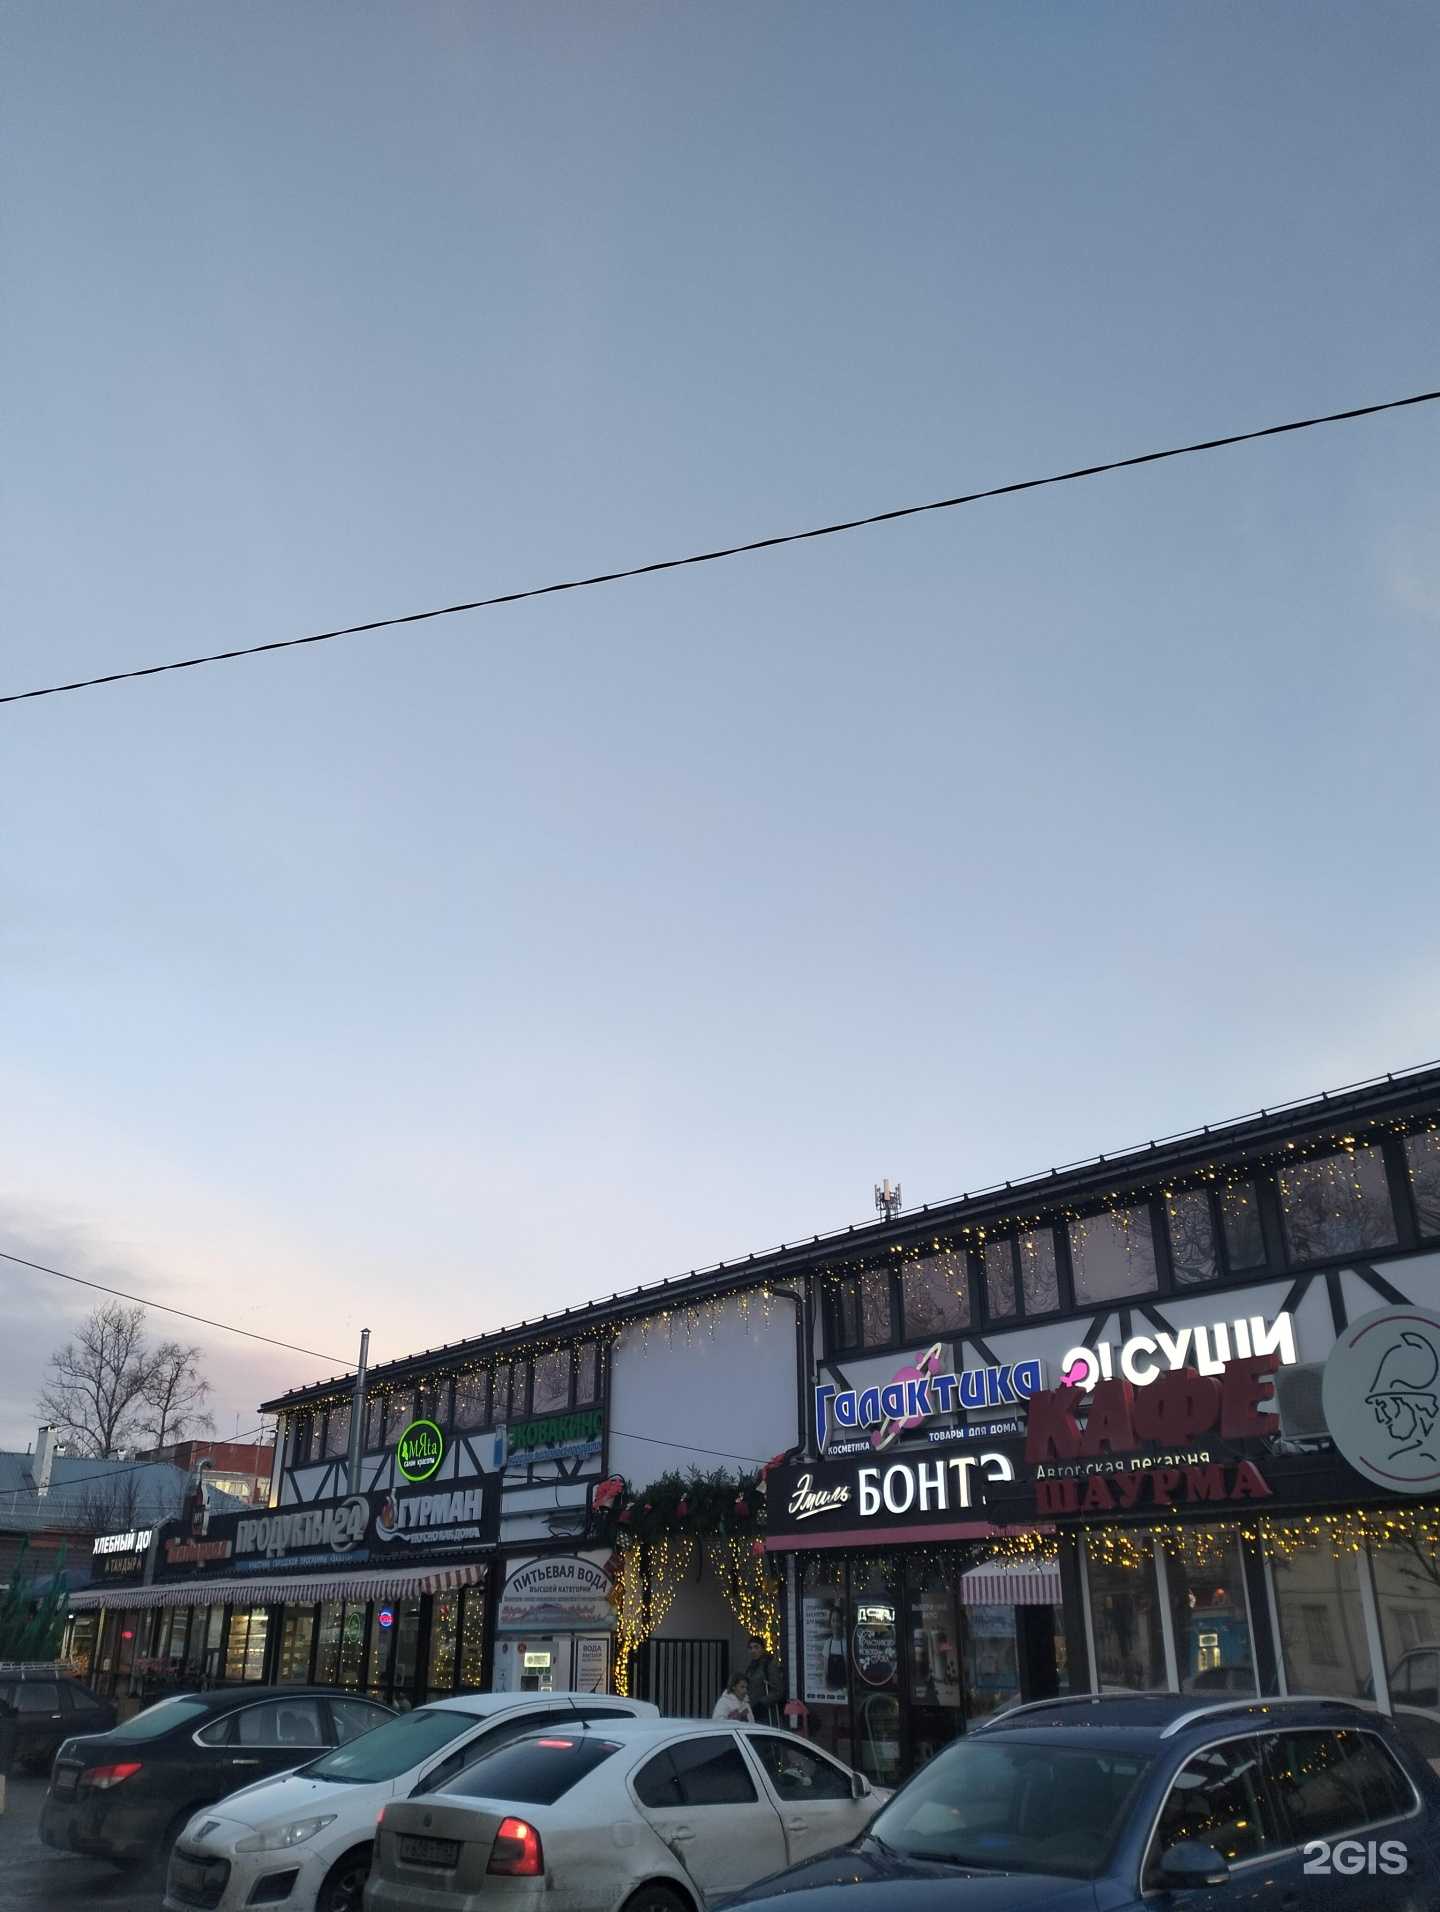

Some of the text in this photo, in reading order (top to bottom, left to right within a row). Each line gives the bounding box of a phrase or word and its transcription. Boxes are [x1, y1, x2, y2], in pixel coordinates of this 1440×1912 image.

[815, 1359, 1043, 1454] Галактика
[1024, 1354, 1281, 1463] КАФЕ
[827, 1441, 870, 1455] КОСМЕТИКА
[928, 1422, 1017, 1442] ТОВАРЫ ДЛЯ ДОМА
[788, 1473, 850, 1515] Эмиль
[1033, 1460, 1272, 1515] ШАУРМА
[398, 1489, 483, 1528] ГУРМАН
[93, 1529, 135, 1554] ХЛЕБНЫЙ
[512, 1565, 608, 1592] ПИТЬЕВАЯ ВОДА
